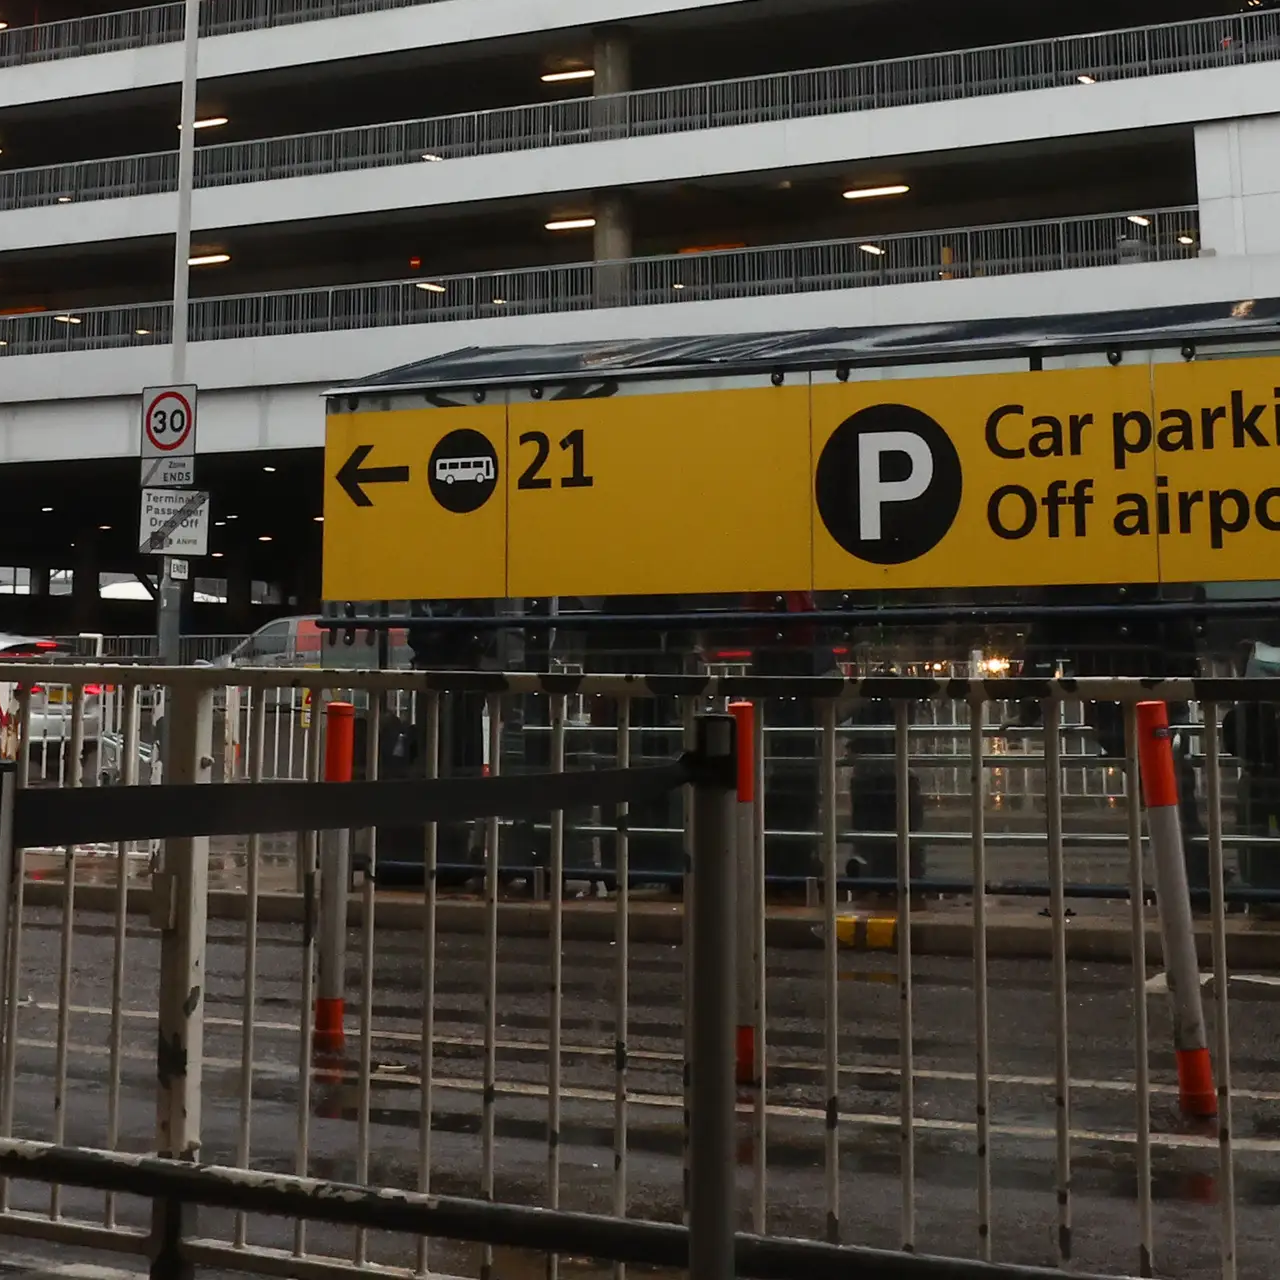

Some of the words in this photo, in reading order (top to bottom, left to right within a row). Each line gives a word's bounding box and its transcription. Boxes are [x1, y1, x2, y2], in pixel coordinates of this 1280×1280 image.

[153, 409, 185, 434] 30
[985, 404, 1094, 459] Car
[163, 472, 191, 482] ENDS
[518, 429, 594, 490] 21
[858, 431, 934, 540] P
[987, 478, 1094, 539] Off
